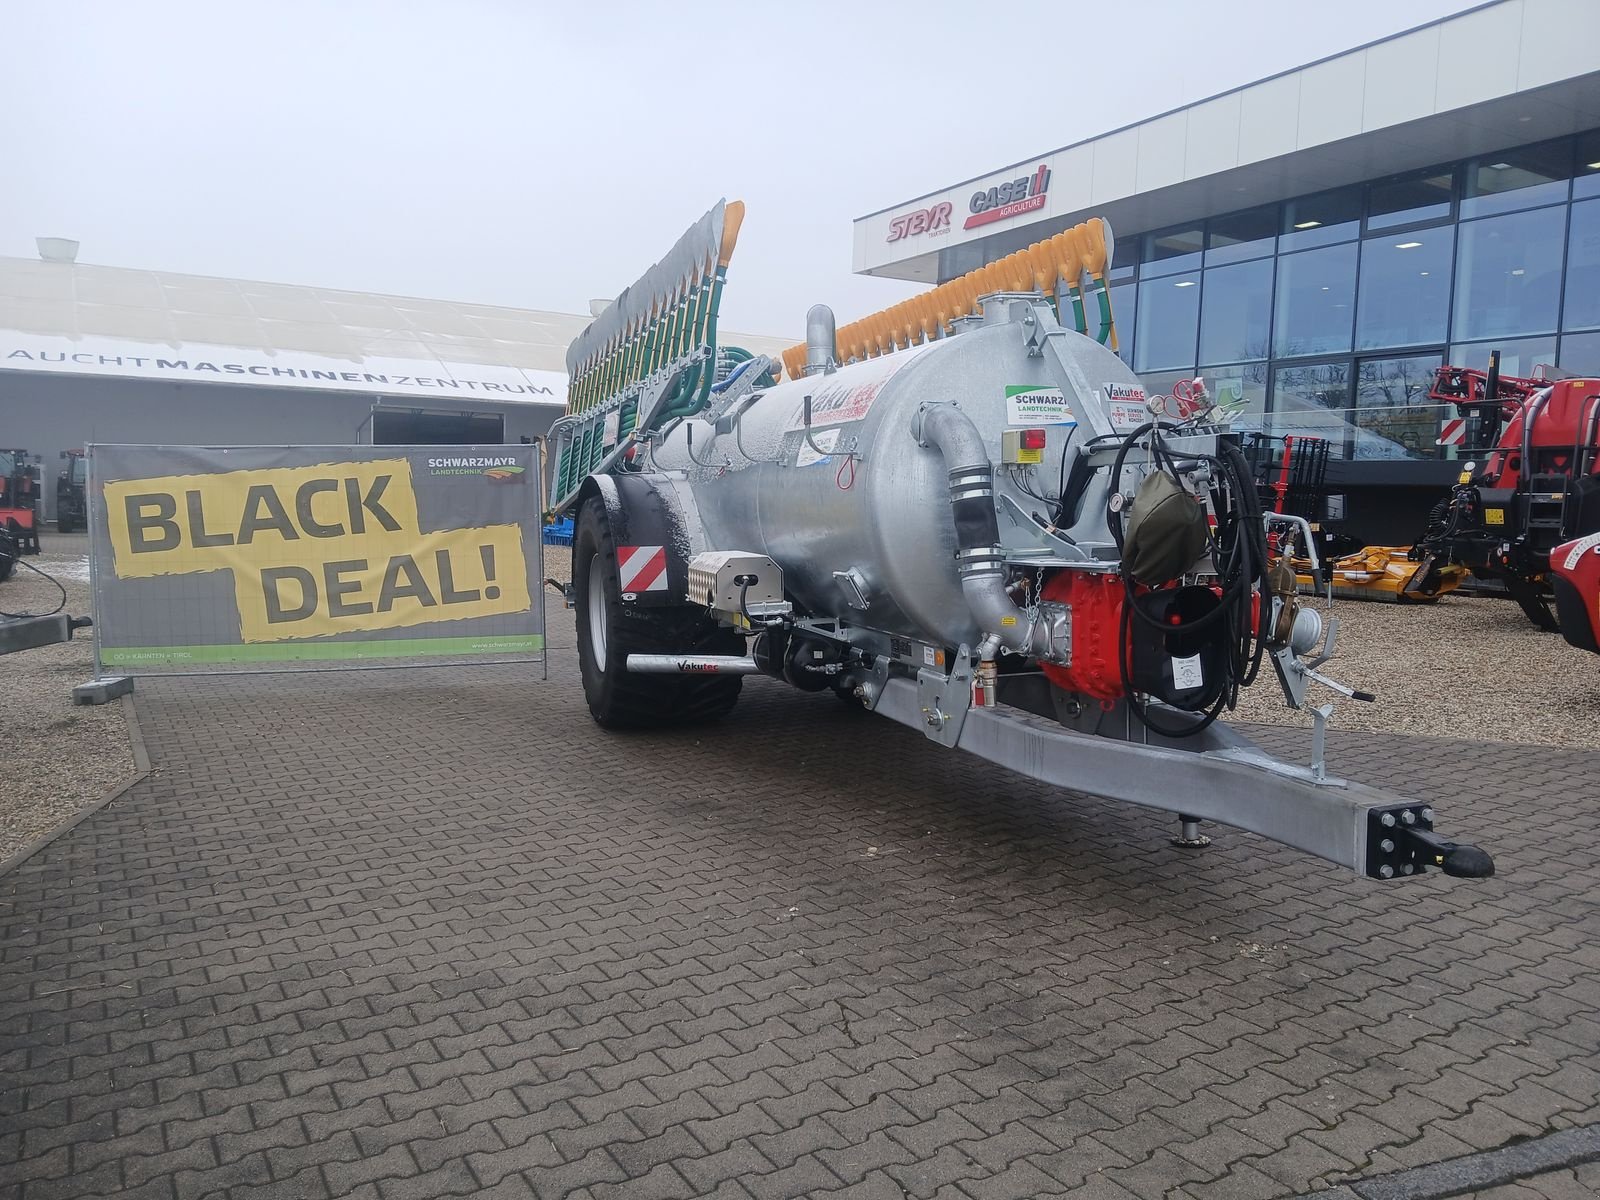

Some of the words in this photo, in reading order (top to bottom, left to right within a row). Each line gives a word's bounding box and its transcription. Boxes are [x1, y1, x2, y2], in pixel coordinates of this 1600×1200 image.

[969, 176, 1029, 214] CASE
[1000, 198, 1041, 217] AGRICULTURE
[886, 201, 953, 243] STEYR
[1015, 395, 1067, 405] SCHWARZ
[1104, 384, 1145, 400] Vakutec
[428, 457, 516, 468] SCHWARZMAYR
[431, 468, 482, 476] LANDTECHNIK
[124, 474, 402, 554] BLACK
[260, 544, 501, 624] DEAL!
[173, 651, 192, 659] TIROL
[677, 660, 719, 671] Vakutec
